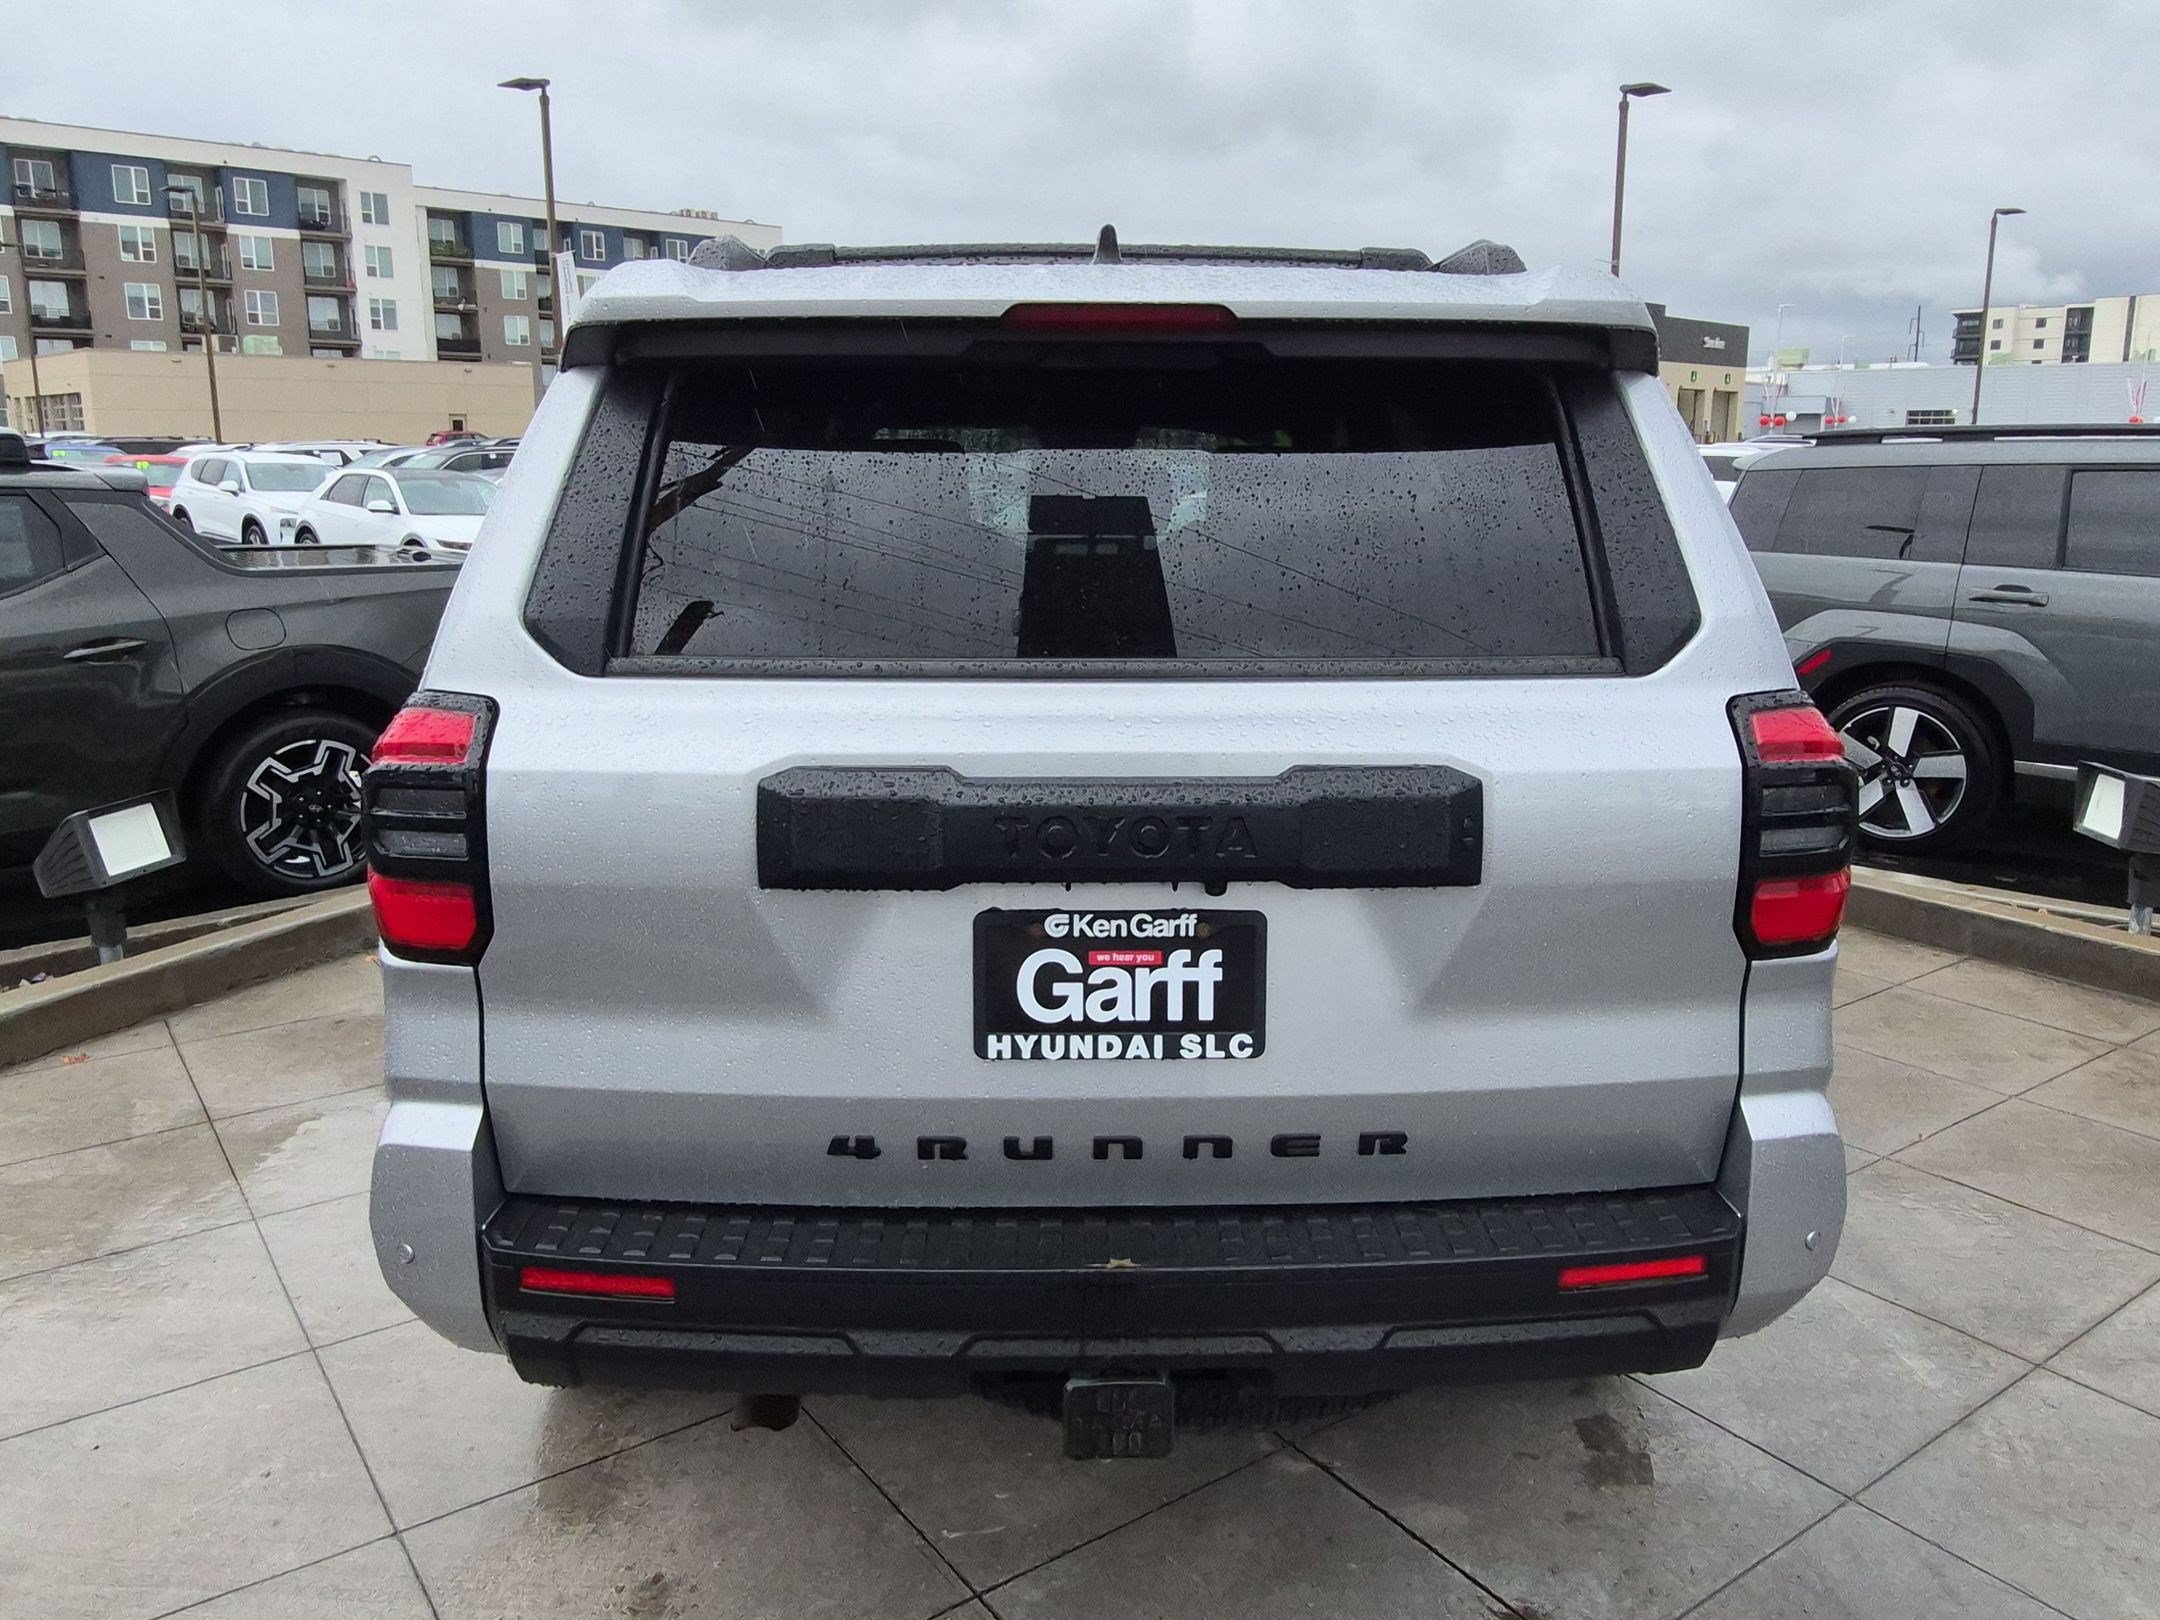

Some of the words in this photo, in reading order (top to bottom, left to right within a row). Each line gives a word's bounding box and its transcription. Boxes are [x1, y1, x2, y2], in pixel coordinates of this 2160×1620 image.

[994, 815, 1256, 859] TOYOTA
[1130, 913, 1198, 938] Garff
[1096, 953, 1110, 962] we
[1112, 952, 1134, 962] hear
[1136, 953, 1155, 964] you
[1016, 948, 1223, 1023] Garff
[987, 1034, 1163, 1060] HYUNDAI
[1180, 1033, 1254, 1059] SLC
[826, 1130, 1409, 1161] 4RUNNER
